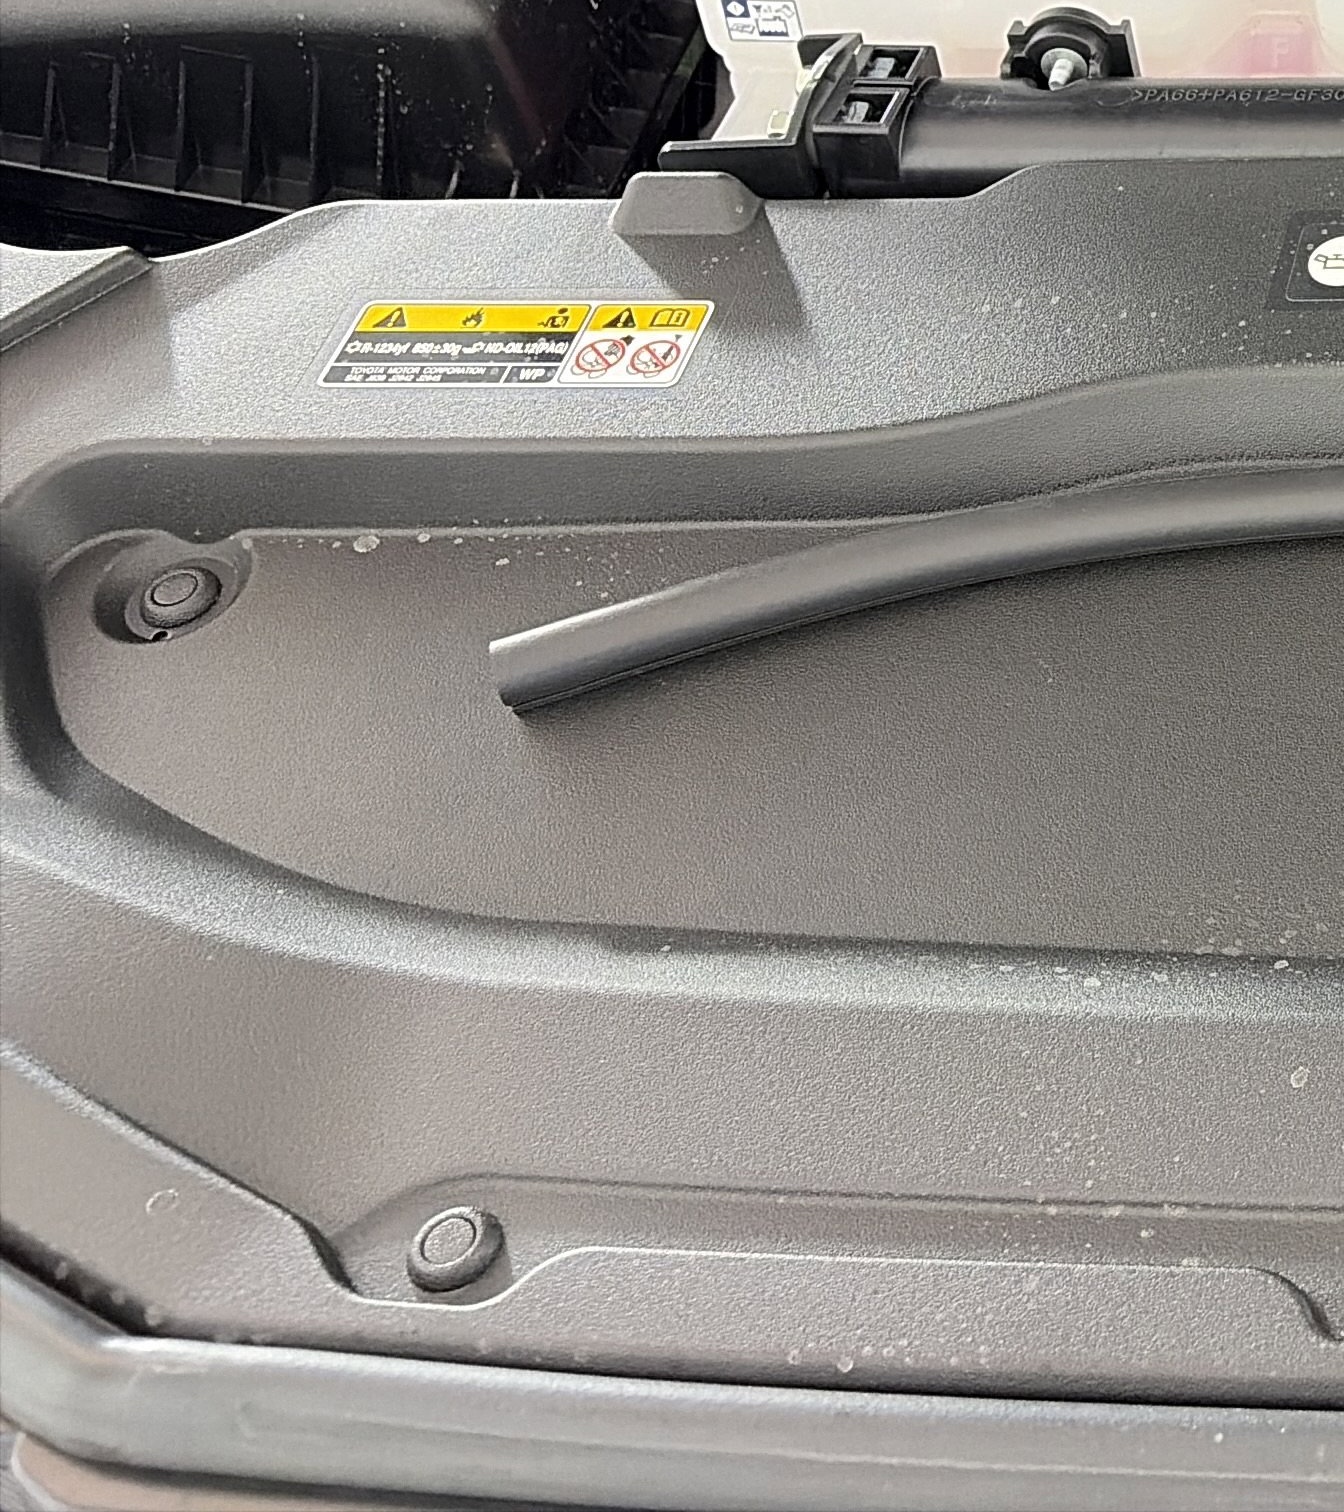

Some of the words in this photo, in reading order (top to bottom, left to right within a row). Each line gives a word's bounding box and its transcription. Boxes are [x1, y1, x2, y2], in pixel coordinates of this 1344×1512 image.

[350, 366, 385, 375] TOYOTA
[386, 366, 421, 375] MOTOR
[422, 366, 487, 375] CORPORATION
[519, 368, 546, 381] WP
